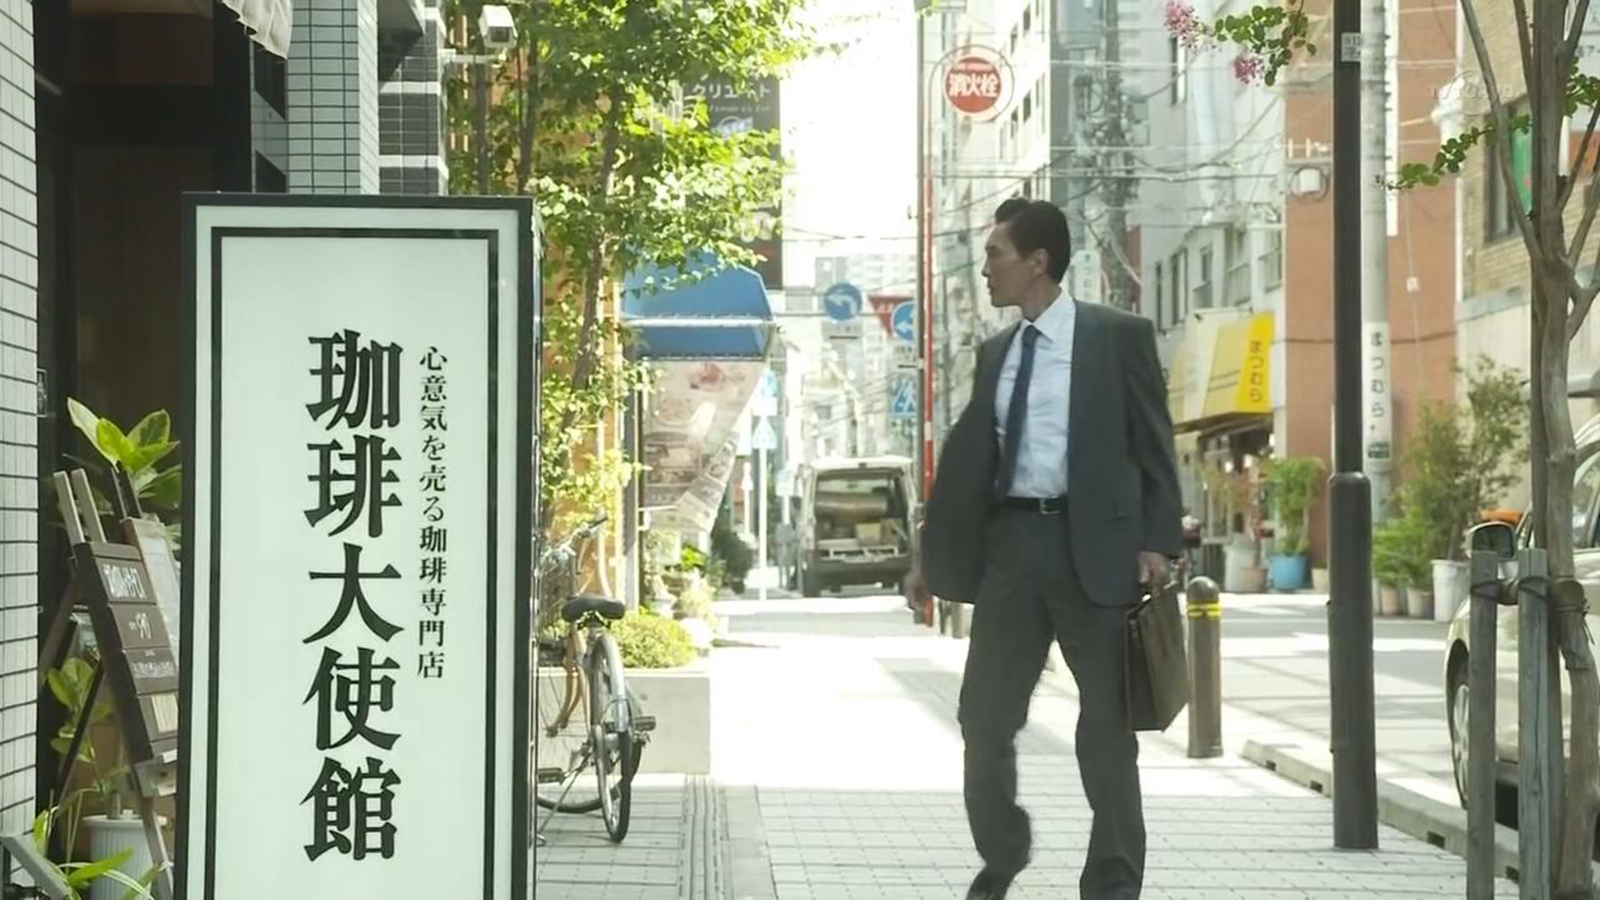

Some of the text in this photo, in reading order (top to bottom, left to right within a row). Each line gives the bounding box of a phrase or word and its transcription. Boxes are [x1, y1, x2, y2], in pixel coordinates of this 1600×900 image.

[948, 72, 999, 97] 消火栓
[1249, 340, 1265, 403] まつむら
[1369, 331, 1385, 418] まつむら
[418, 346, 447, 678] 心意気を売る珈琲専門店
[301, 329, 404, 861] 珈琲大使館
